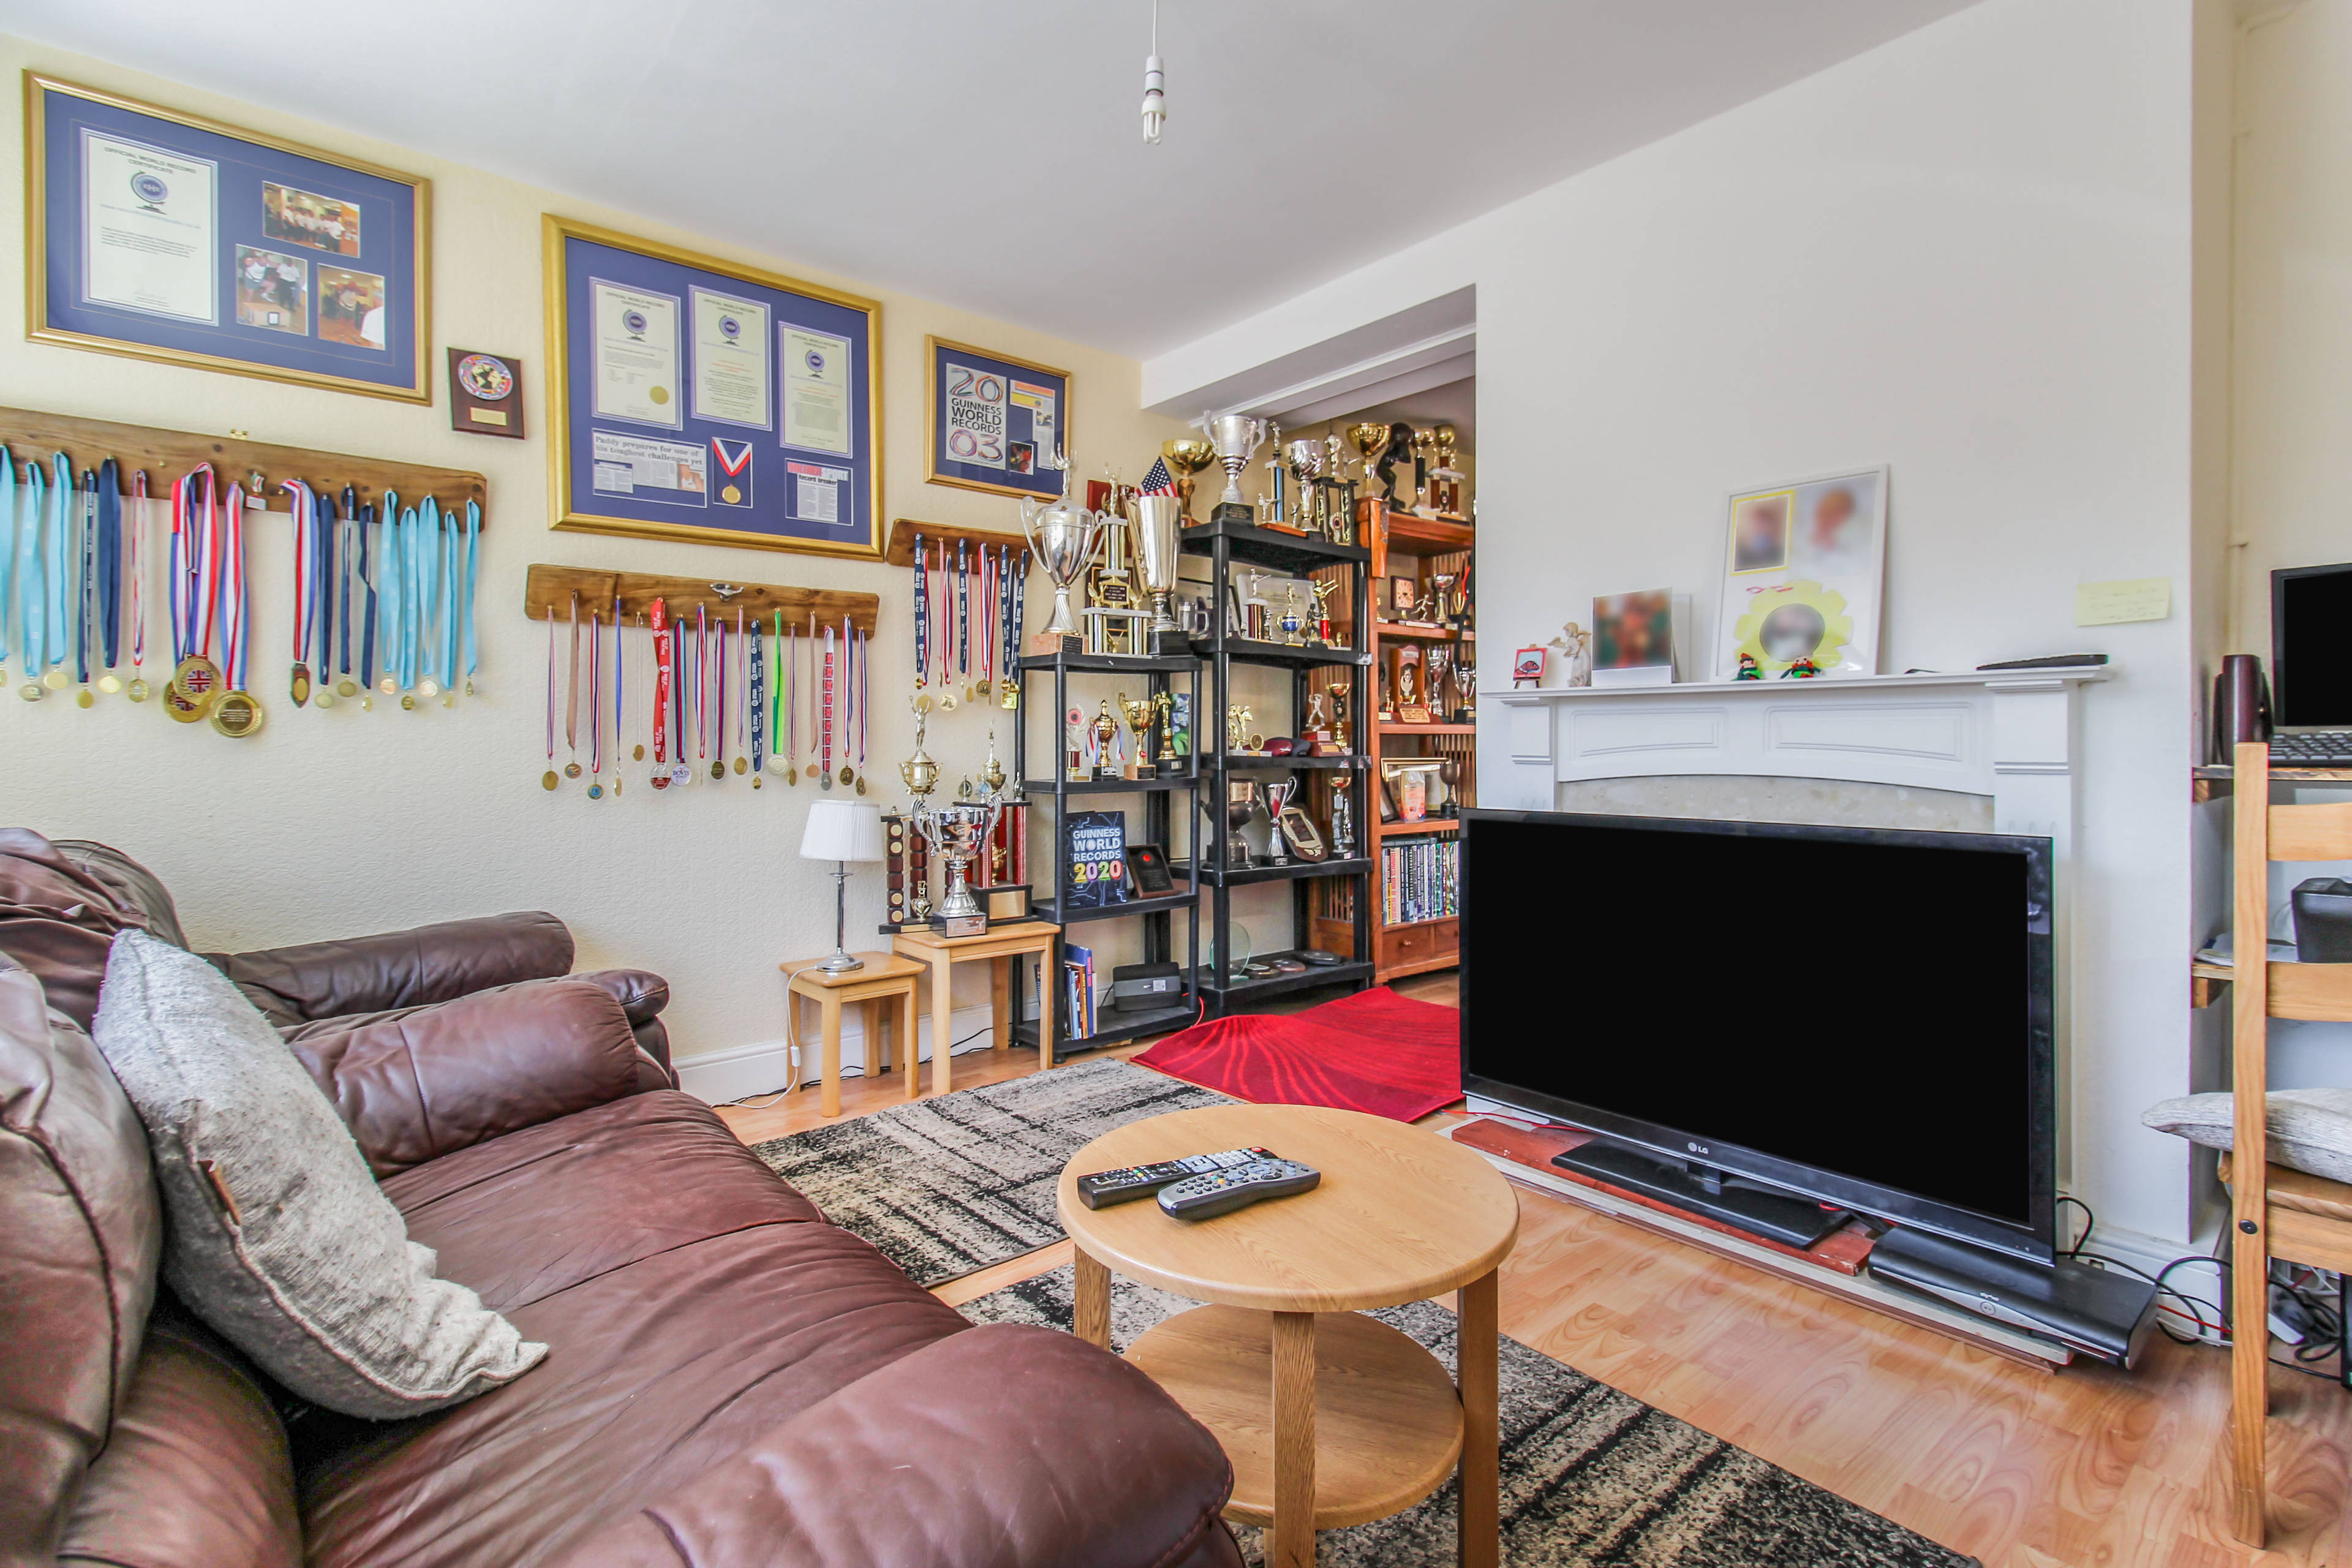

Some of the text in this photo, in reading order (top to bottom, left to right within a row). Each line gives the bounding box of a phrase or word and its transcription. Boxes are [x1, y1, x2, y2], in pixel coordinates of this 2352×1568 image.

[138, 154, 166, 166] WORLD
[167, 162, 197, 175] RECORD
[951, 398, 1001, 416] GUINNESS
[951, 405, 1002, 426] WORLD
[951, 417, 1002, 435] RECORDS
[595, 435, 620, 448] Paddy
[622, 440, 658, 451] prepares
[595, 444, 608, 453] his
[609, 447, 646, 458] toughest
[647, 453, 689, 464] challenges
[1073, 827, 1120, 839] GUINNESS
[1073, 837, 1121, 852] WORLD
[1074, 850, 1121, 862] RECORDS
[1074, 860, 1123, 883] 2020
[1697, 1146, 1709, 1155] LG
